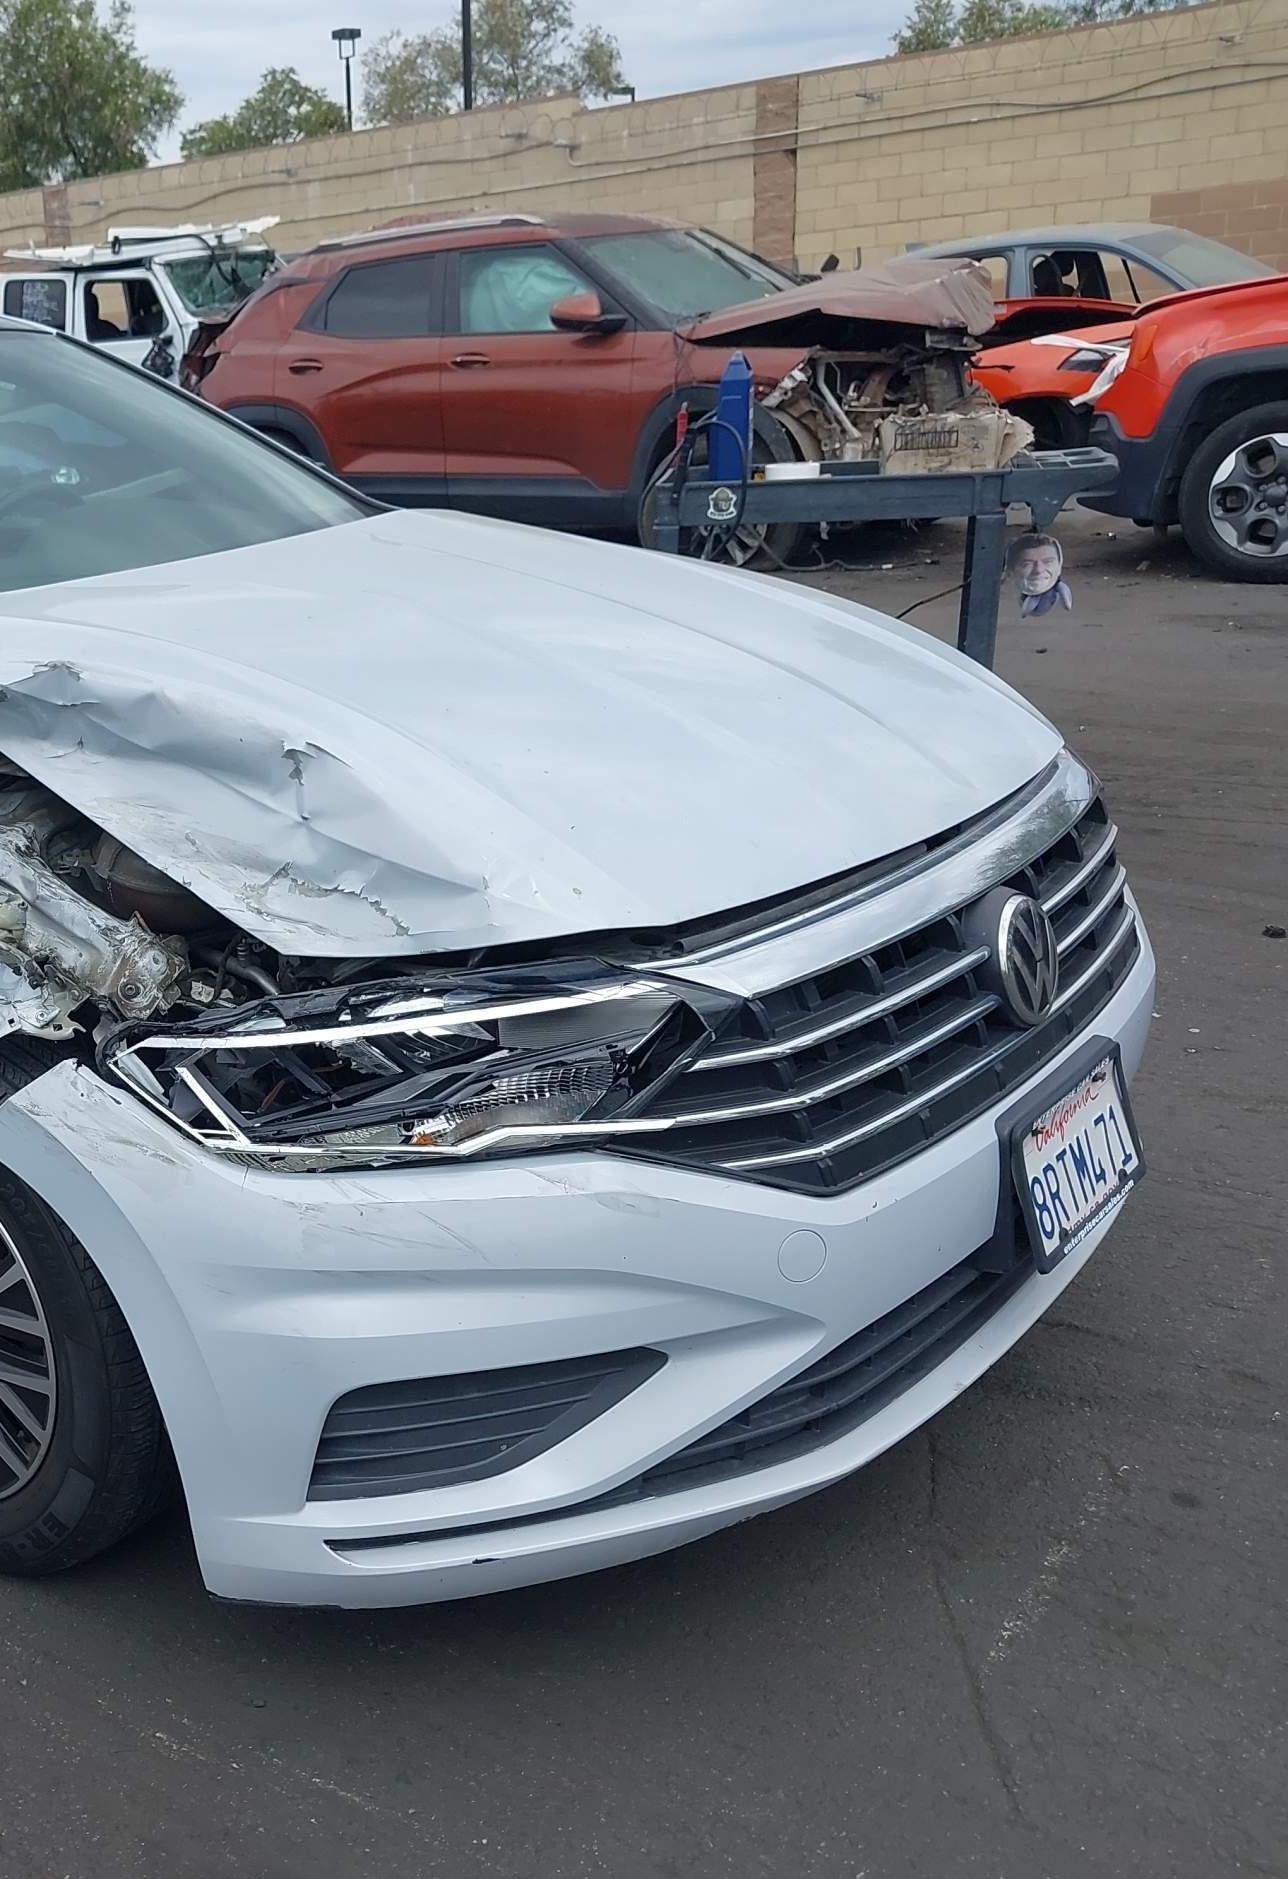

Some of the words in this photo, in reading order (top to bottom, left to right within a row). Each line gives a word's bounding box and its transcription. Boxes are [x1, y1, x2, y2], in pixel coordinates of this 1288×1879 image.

[1034, 1085, 1100, 1152] California
[1030, 1104, 1133, 1240] 8RTM471
[1063, 1178, 1135, 1255] enterprisecarsales.com
